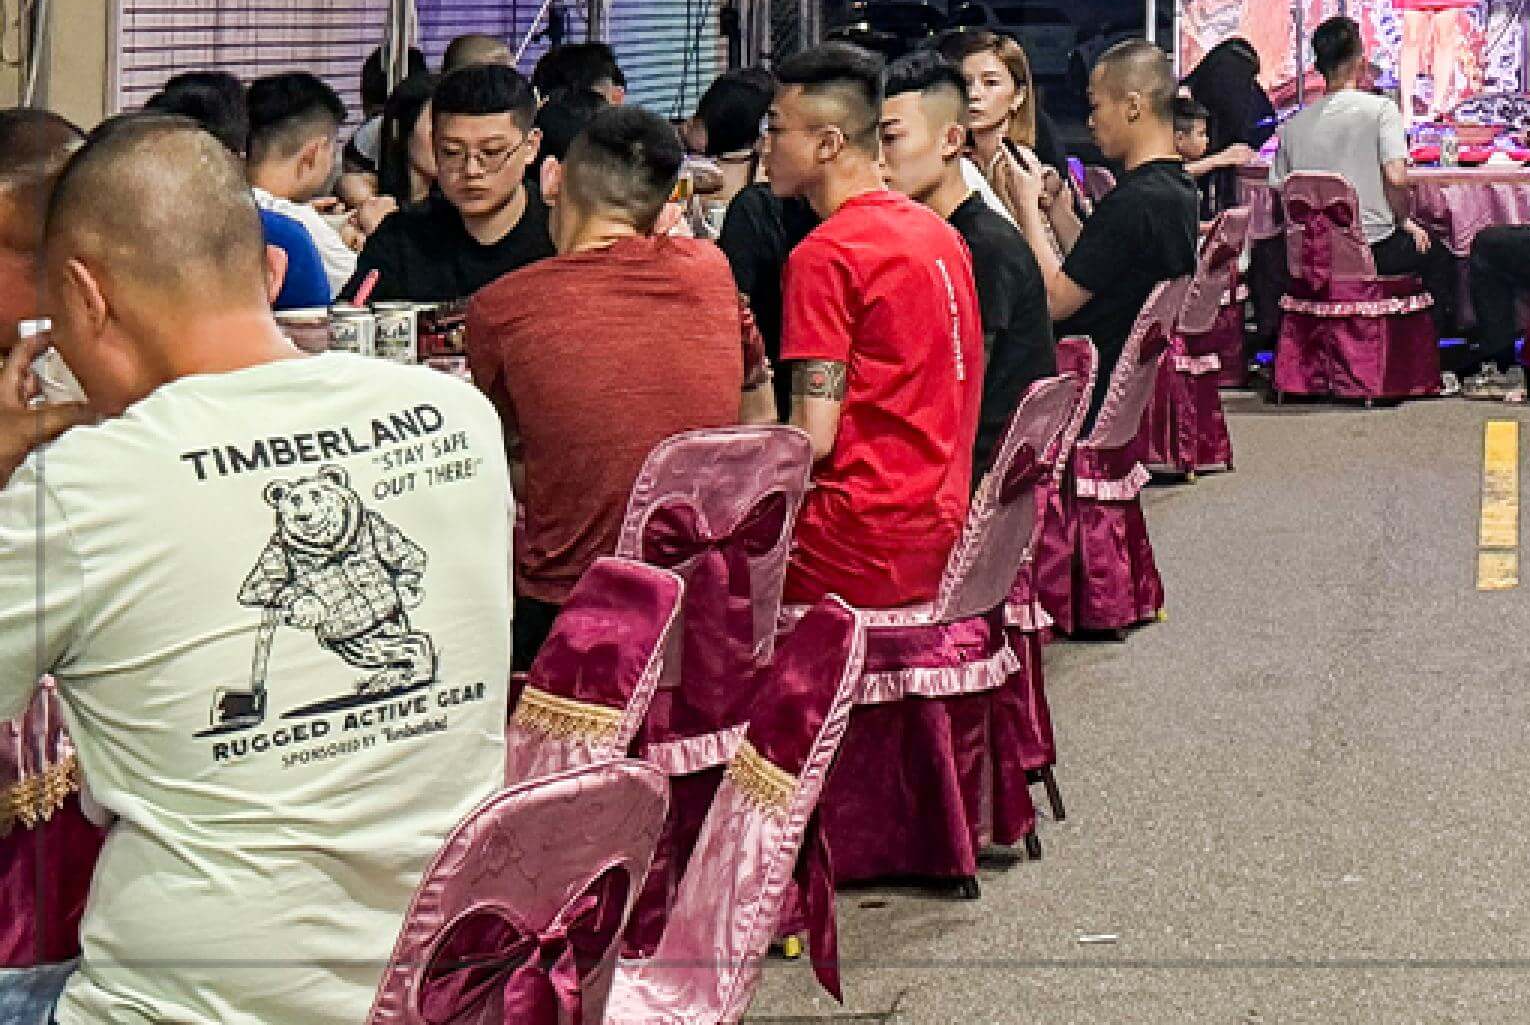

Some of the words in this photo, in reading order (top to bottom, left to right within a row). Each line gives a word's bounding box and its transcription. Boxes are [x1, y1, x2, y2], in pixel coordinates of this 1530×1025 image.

[180, 404, 445, 481] TIMBERLAND
[373, 472, 415, 501] OUT
[212, 719, 331, 762] RUGGED
[341, 694, 429, 732] ACTIVE
[437, 681, 487, 708] GEAR
